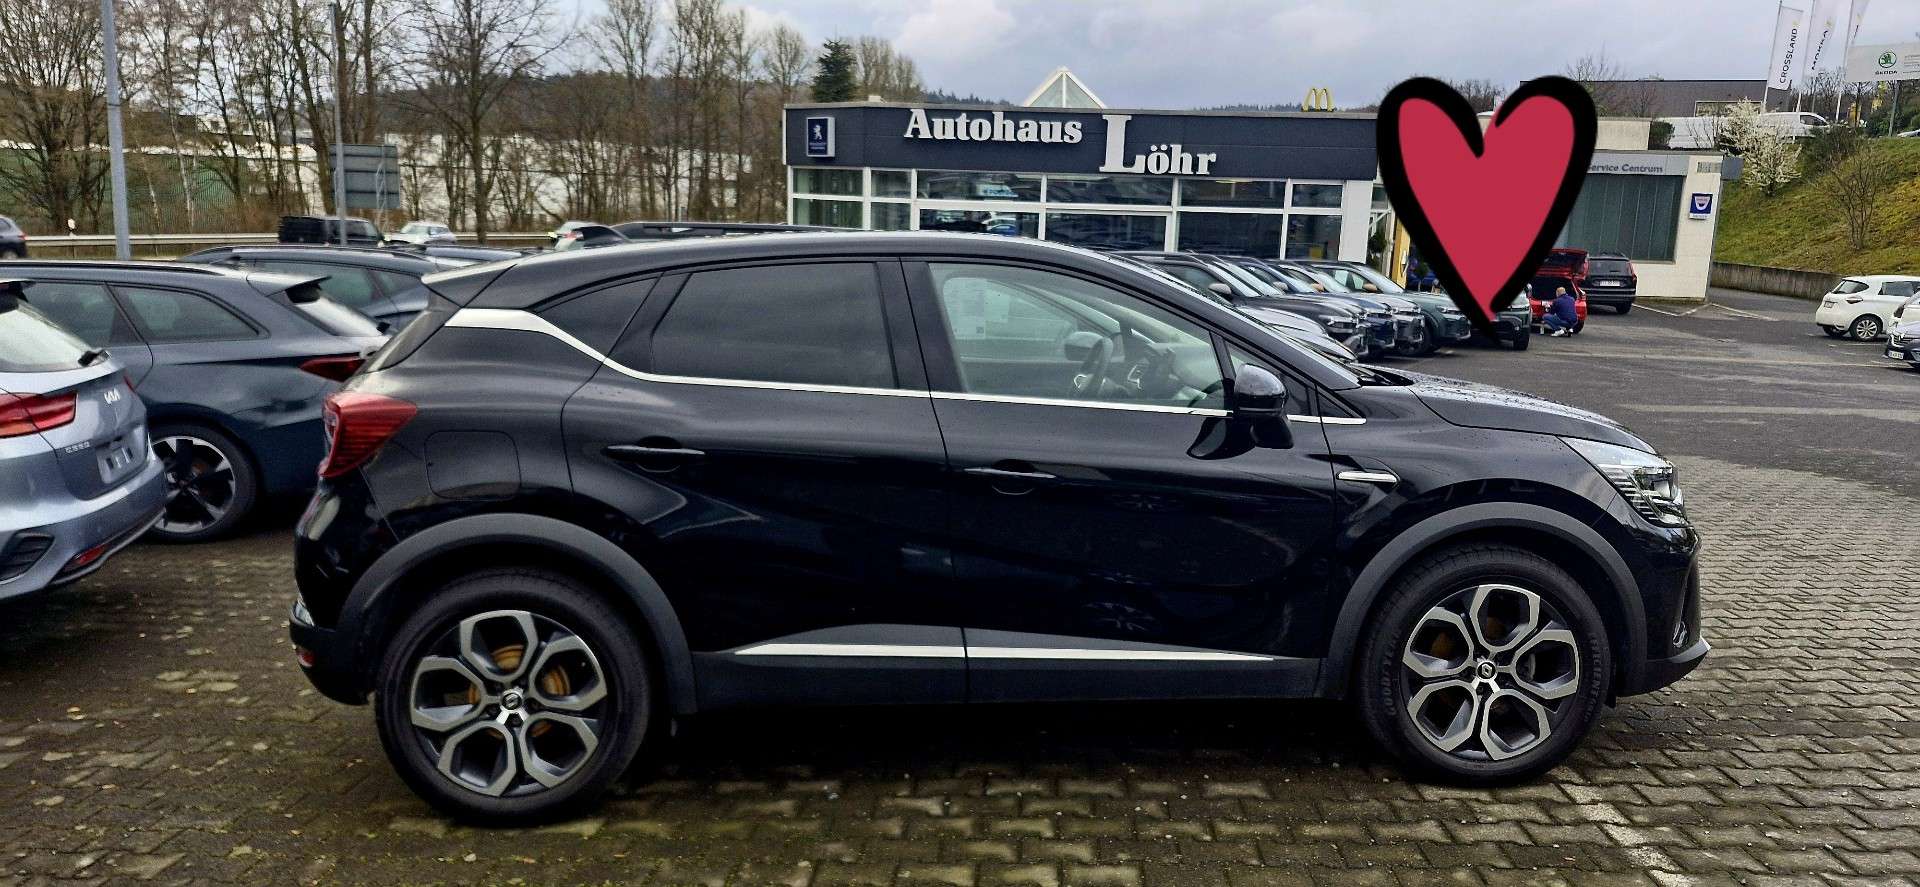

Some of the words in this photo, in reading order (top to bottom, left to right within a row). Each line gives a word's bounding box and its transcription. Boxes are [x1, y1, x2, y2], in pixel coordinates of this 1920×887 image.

[1780, 28, 1798, 83] CROSSLAND
[904, 108, 1083, 144] Autohaus
[1099, 114, 1217, 175] Löhr
[1589, 163, 1619, 173] ervice
[1621, 163, 1663, 174] Centrum
